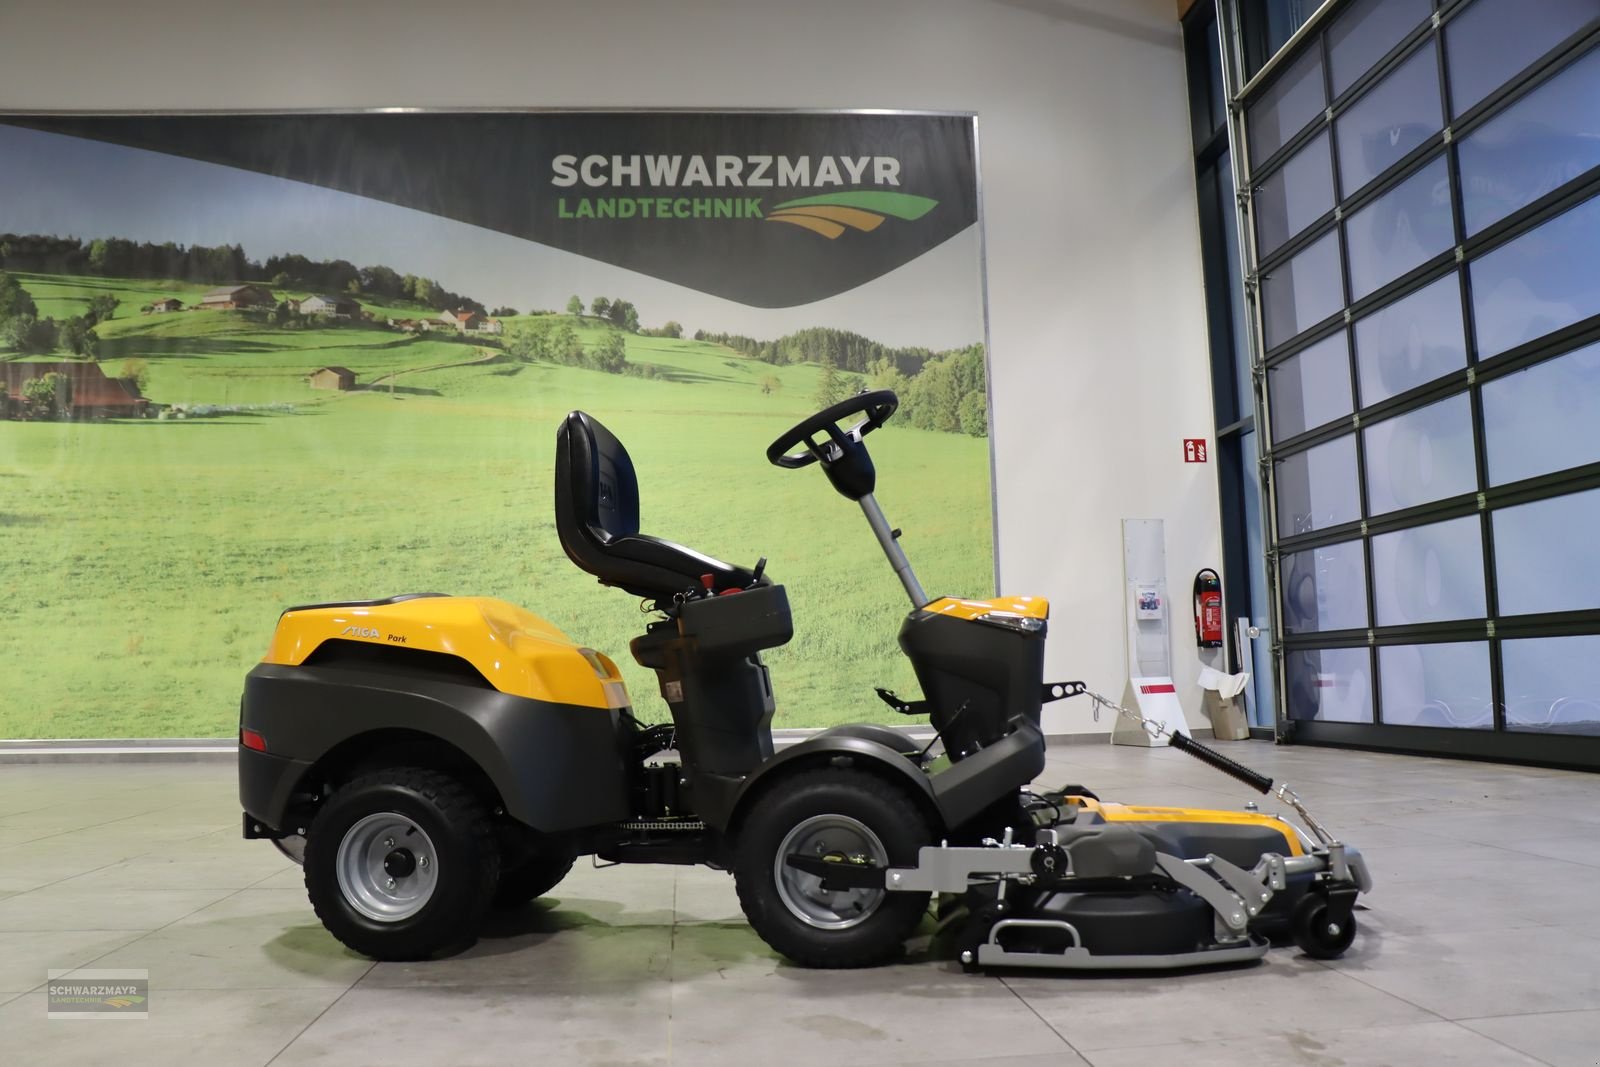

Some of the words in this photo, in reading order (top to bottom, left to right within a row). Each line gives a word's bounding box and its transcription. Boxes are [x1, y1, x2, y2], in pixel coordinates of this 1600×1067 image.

[551, 154, 901, 187] SCHWARZMAYR
[558, 198, 764, 219] LANDTECHNIK
[341, 625, 380, 639] STIGA
[387, 633, 407, 644] Park
